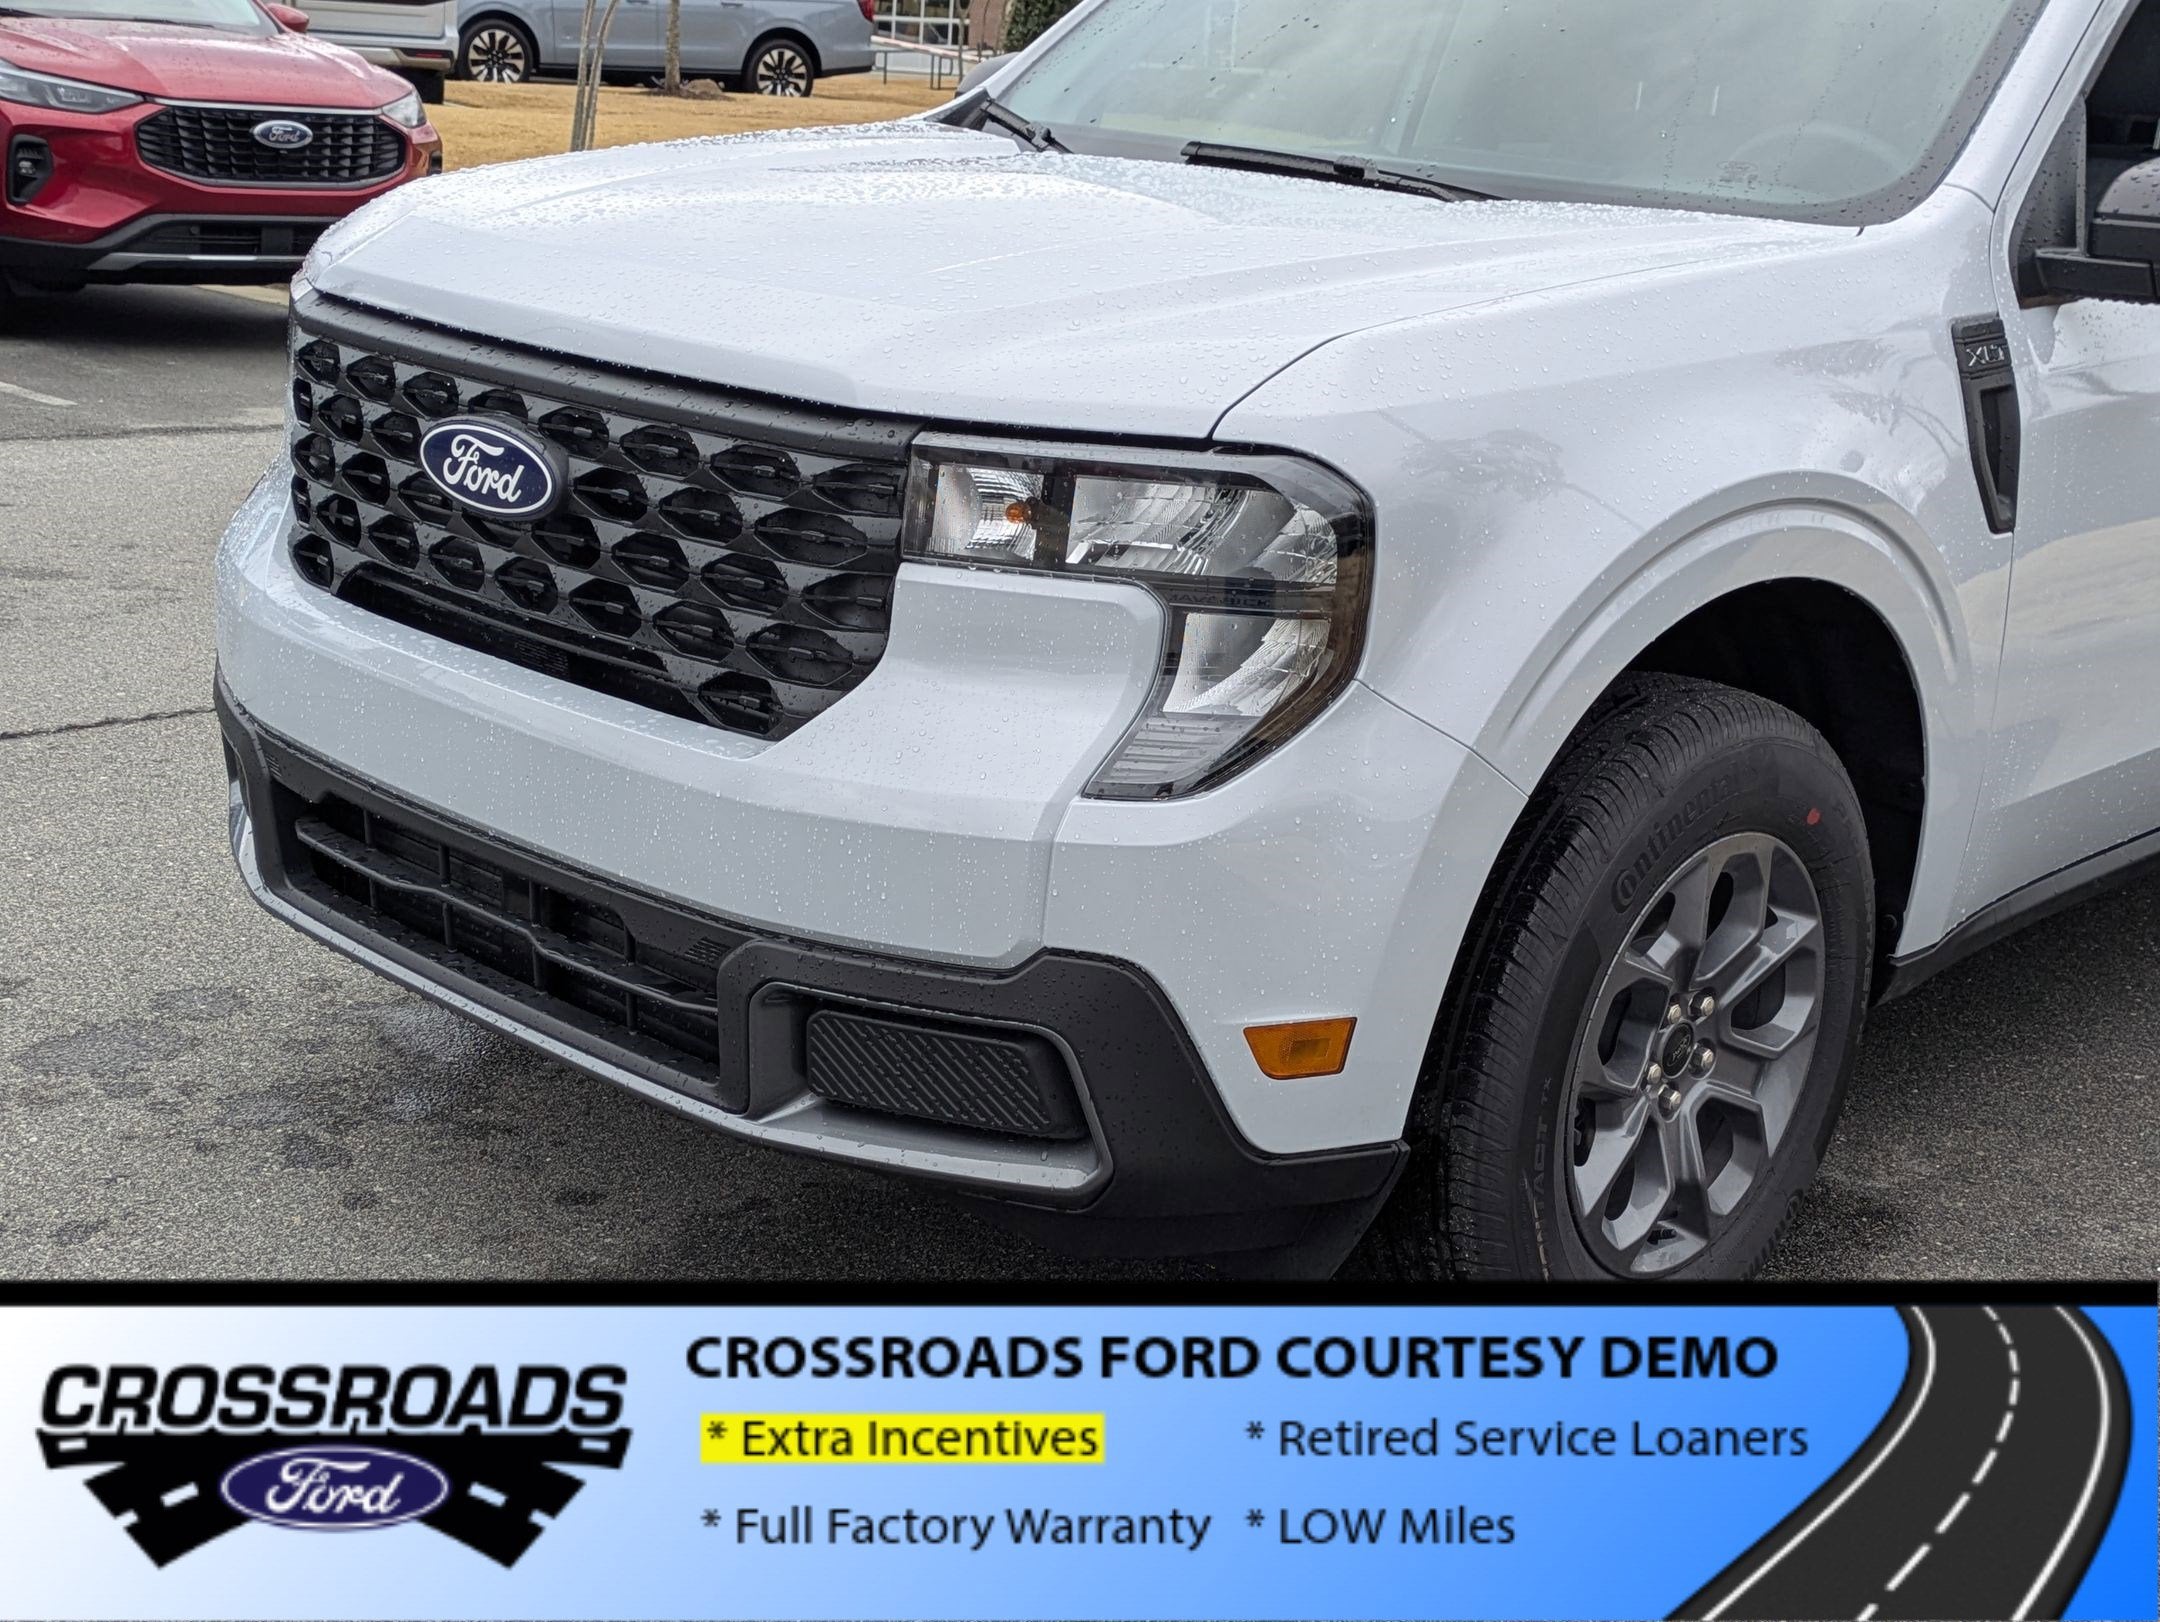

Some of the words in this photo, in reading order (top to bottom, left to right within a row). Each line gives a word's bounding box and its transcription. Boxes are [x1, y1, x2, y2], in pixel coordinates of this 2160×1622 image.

[269, 126, 300, 142] Ford
[1966, 344, 2008, 367] XLT
[443, 434, 525, 503] Ford
[1611, 760, 1741, 914] Continental
